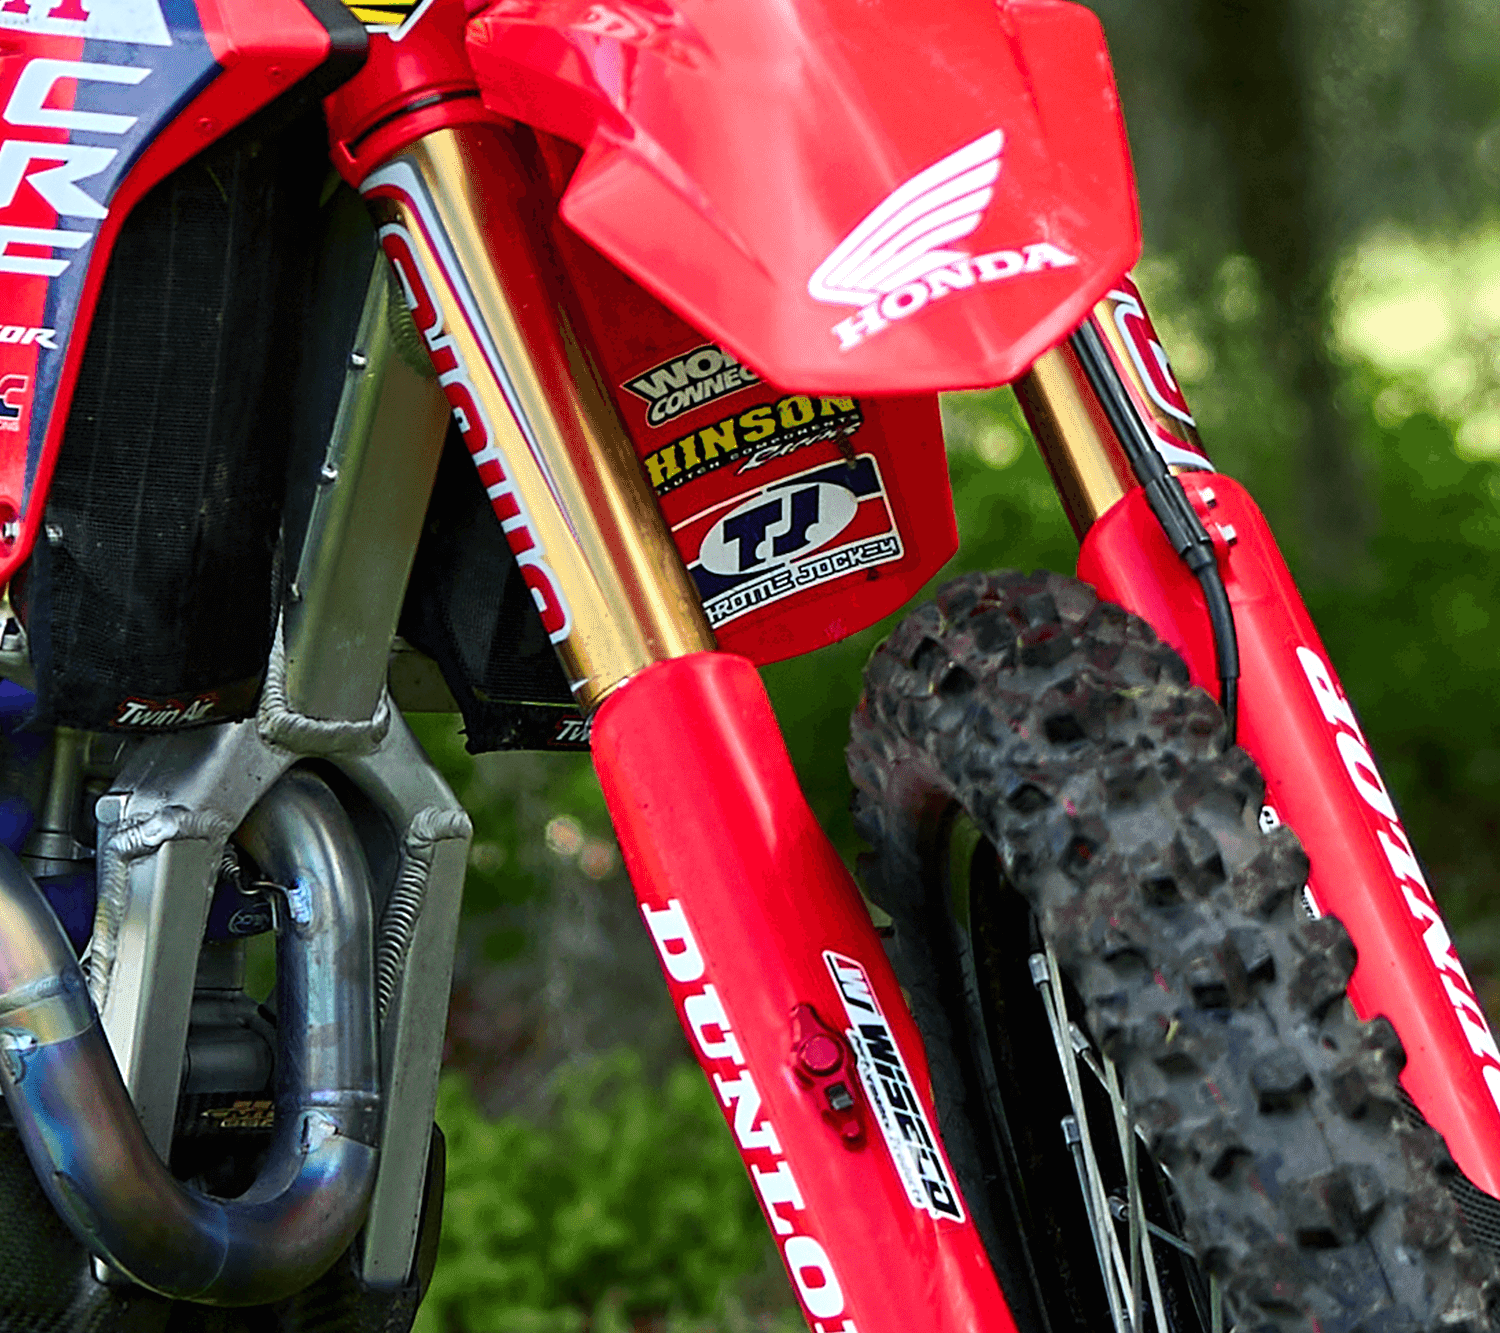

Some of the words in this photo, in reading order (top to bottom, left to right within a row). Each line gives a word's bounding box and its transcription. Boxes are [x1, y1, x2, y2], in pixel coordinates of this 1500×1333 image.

[830, 241, 1080, 352] HONDA
[644, 394, 856, 489] HINSON
[722, 483, 821, 573] TJ
[705, 570, 794, 624] HROTTLE
[797, 535, 898, 584] JOCKEY
[116, 701, 181, 726] Twin
[641, 897, 859, 1333] DUNLO
